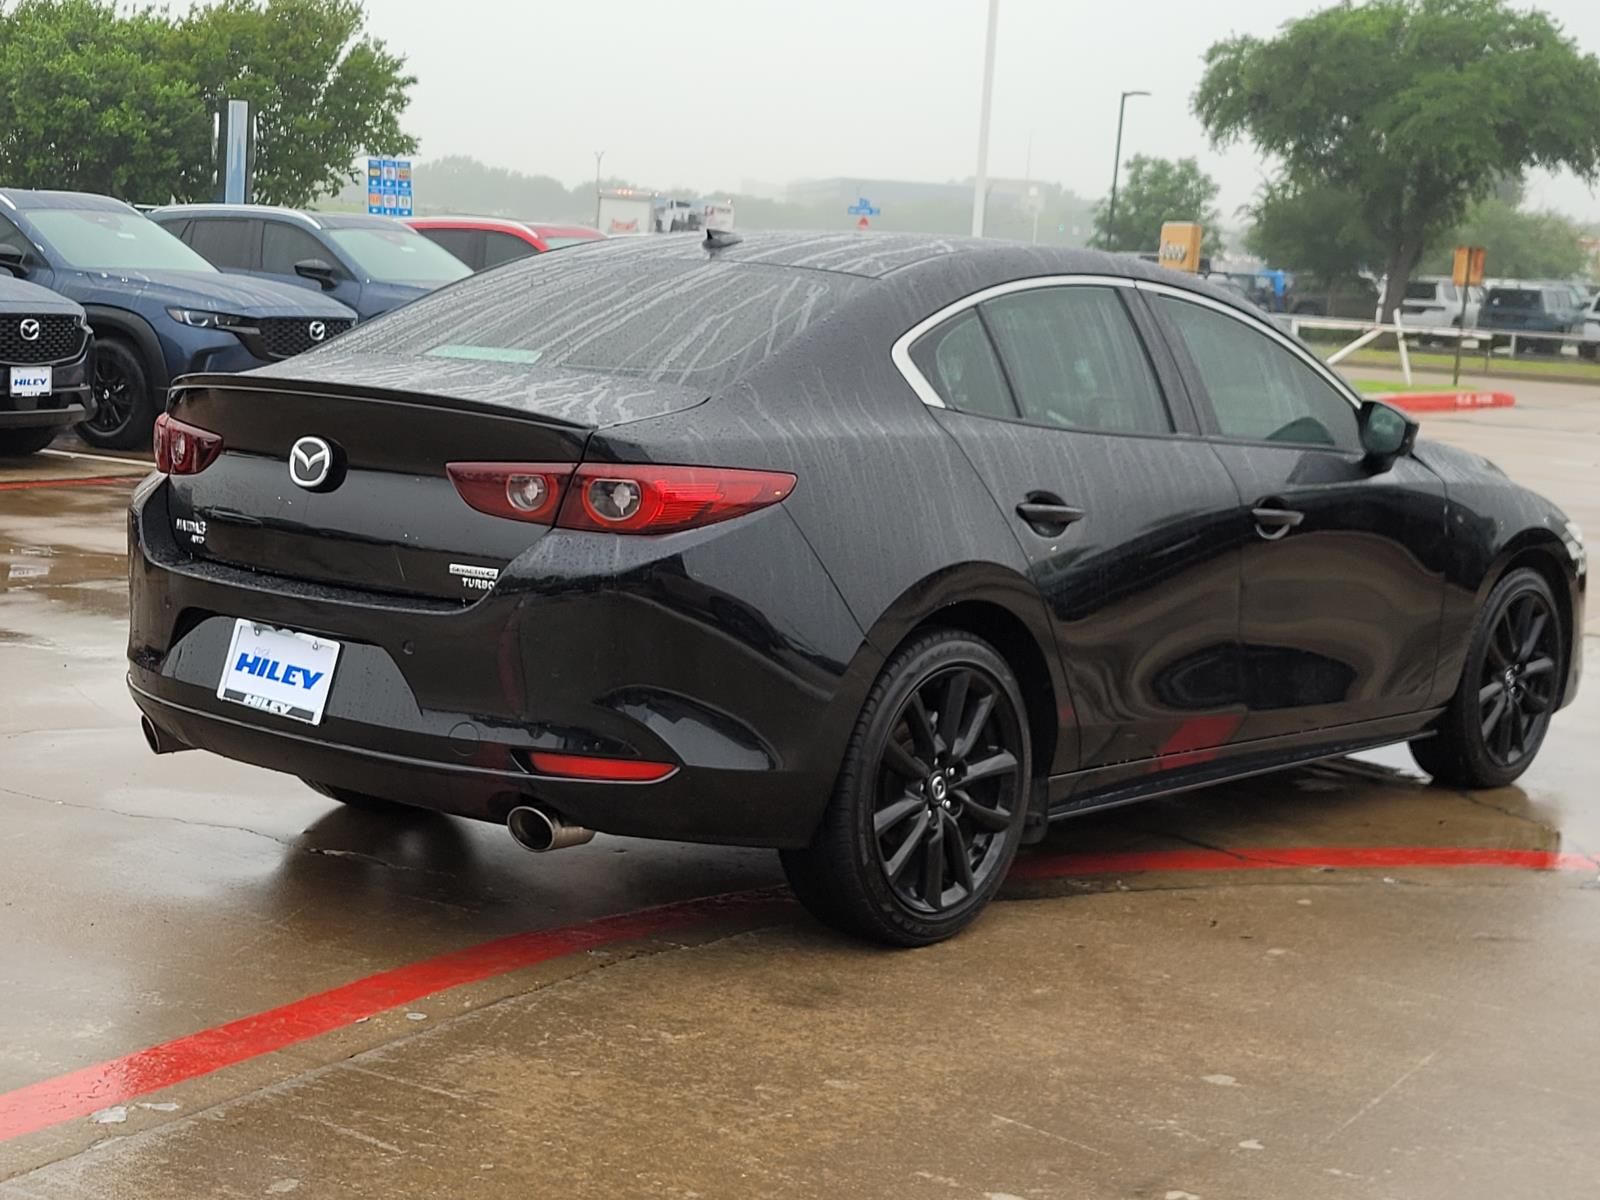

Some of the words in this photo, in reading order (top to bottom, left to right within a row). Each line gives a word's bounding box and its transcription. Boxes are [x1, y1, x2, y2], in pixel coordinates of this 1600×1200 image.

[14, 378, 47, 386] HILEY
[462, 577, 495, 590] TURBO
[235, 653, 324, 690] HILEY
[243, 693, 293, 715] HILEY
